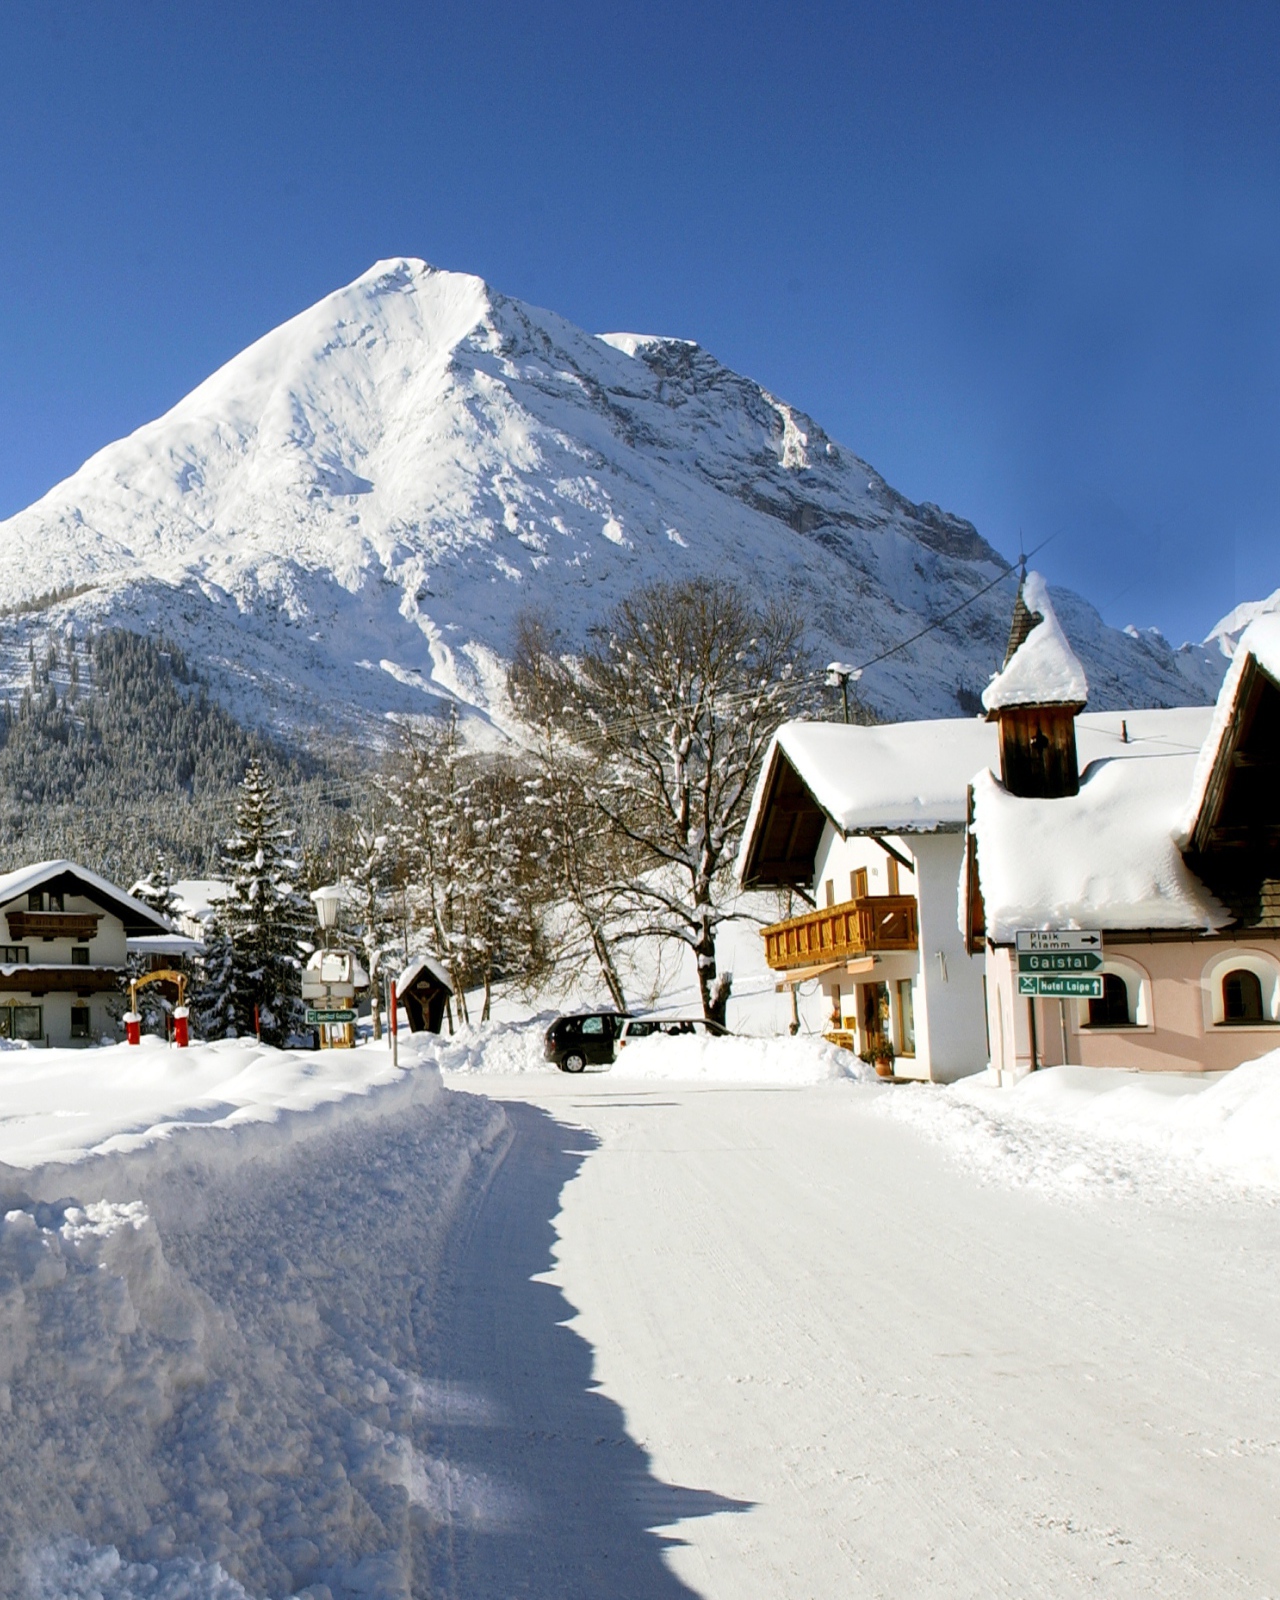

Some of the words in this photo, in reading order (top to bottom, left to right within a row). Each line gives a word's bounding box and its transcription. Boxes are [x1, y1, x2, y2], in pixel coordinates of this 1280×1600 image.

[1030, 941, 1070, 949] Klamm
[1029, 955, 1088, 969] Gaistal
[1041, 981, 1064, 991] Hotel
